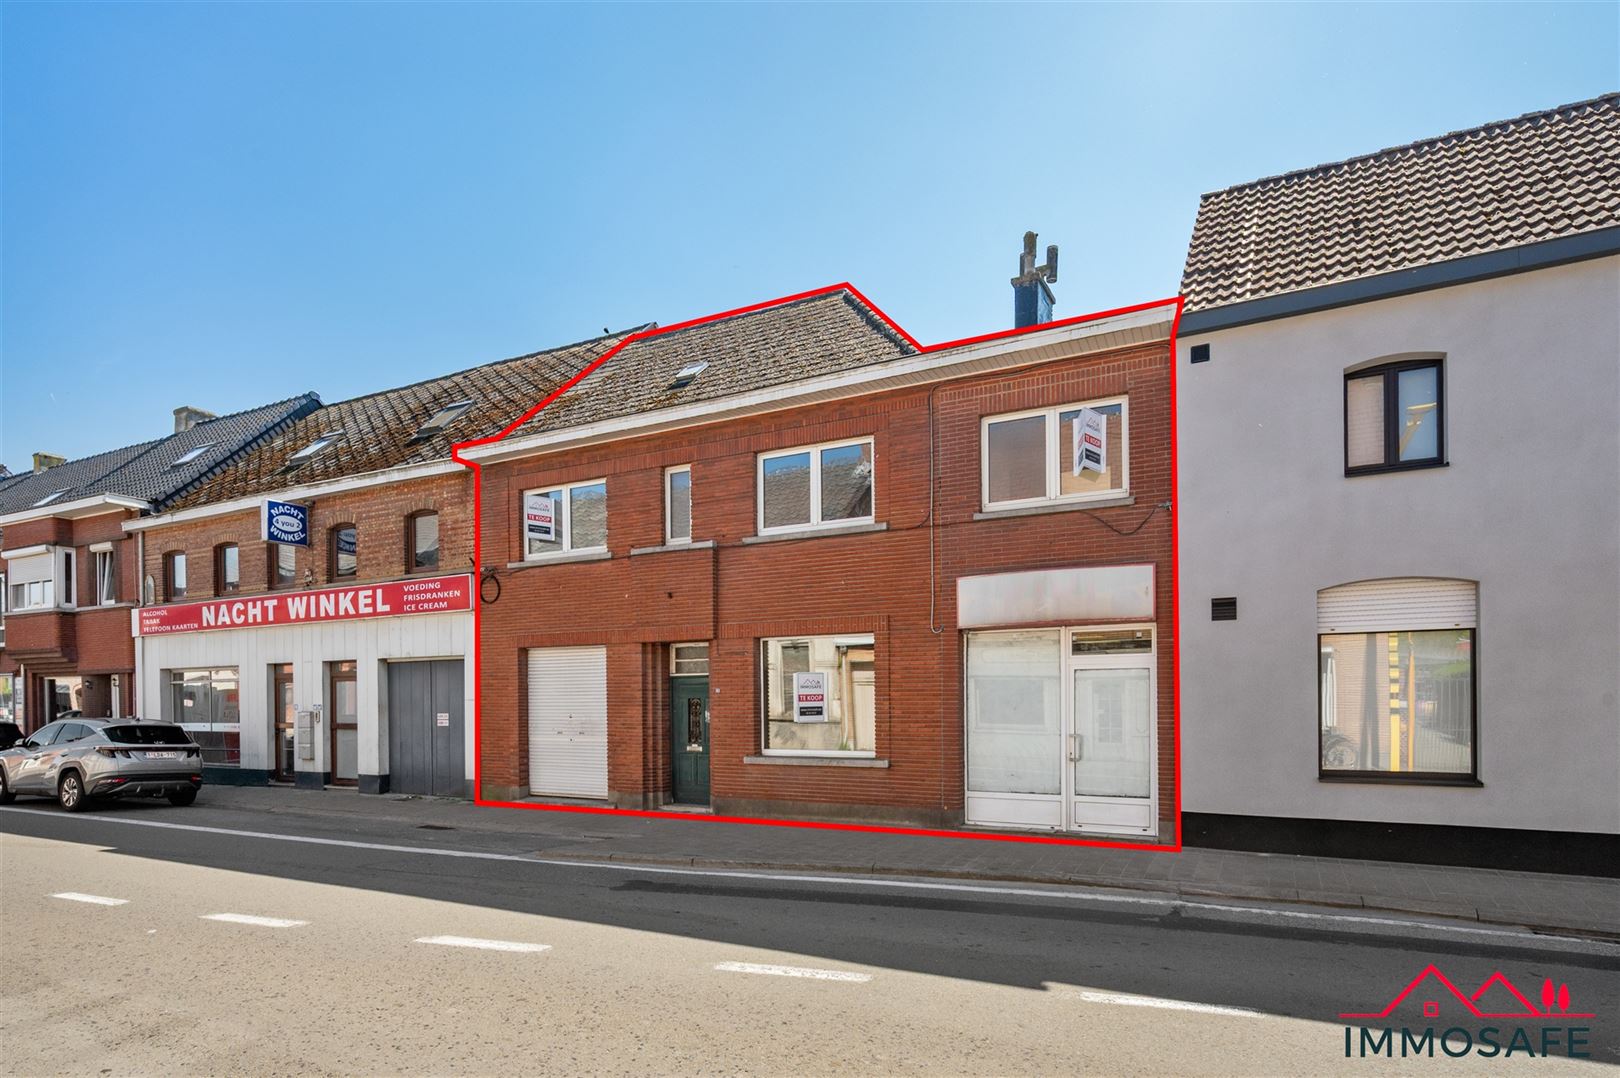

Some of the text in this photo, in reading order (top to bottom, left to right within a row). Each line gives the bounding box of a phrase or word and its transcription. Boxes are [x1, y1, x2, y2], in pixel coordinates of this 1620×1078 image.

[270, 505, 304, 520] NACHT
[270, 525, 306, 541] WINKEL
[403, 582, 441, 592] VOEDING
[403, 590, 461, 601] FRISDRANKEN
[202, 589, 390, 626] NACHT WINKEL
[403, 601, 448, 612] ICE CREAM
[172, 623, 199, 631] KAARTEN
